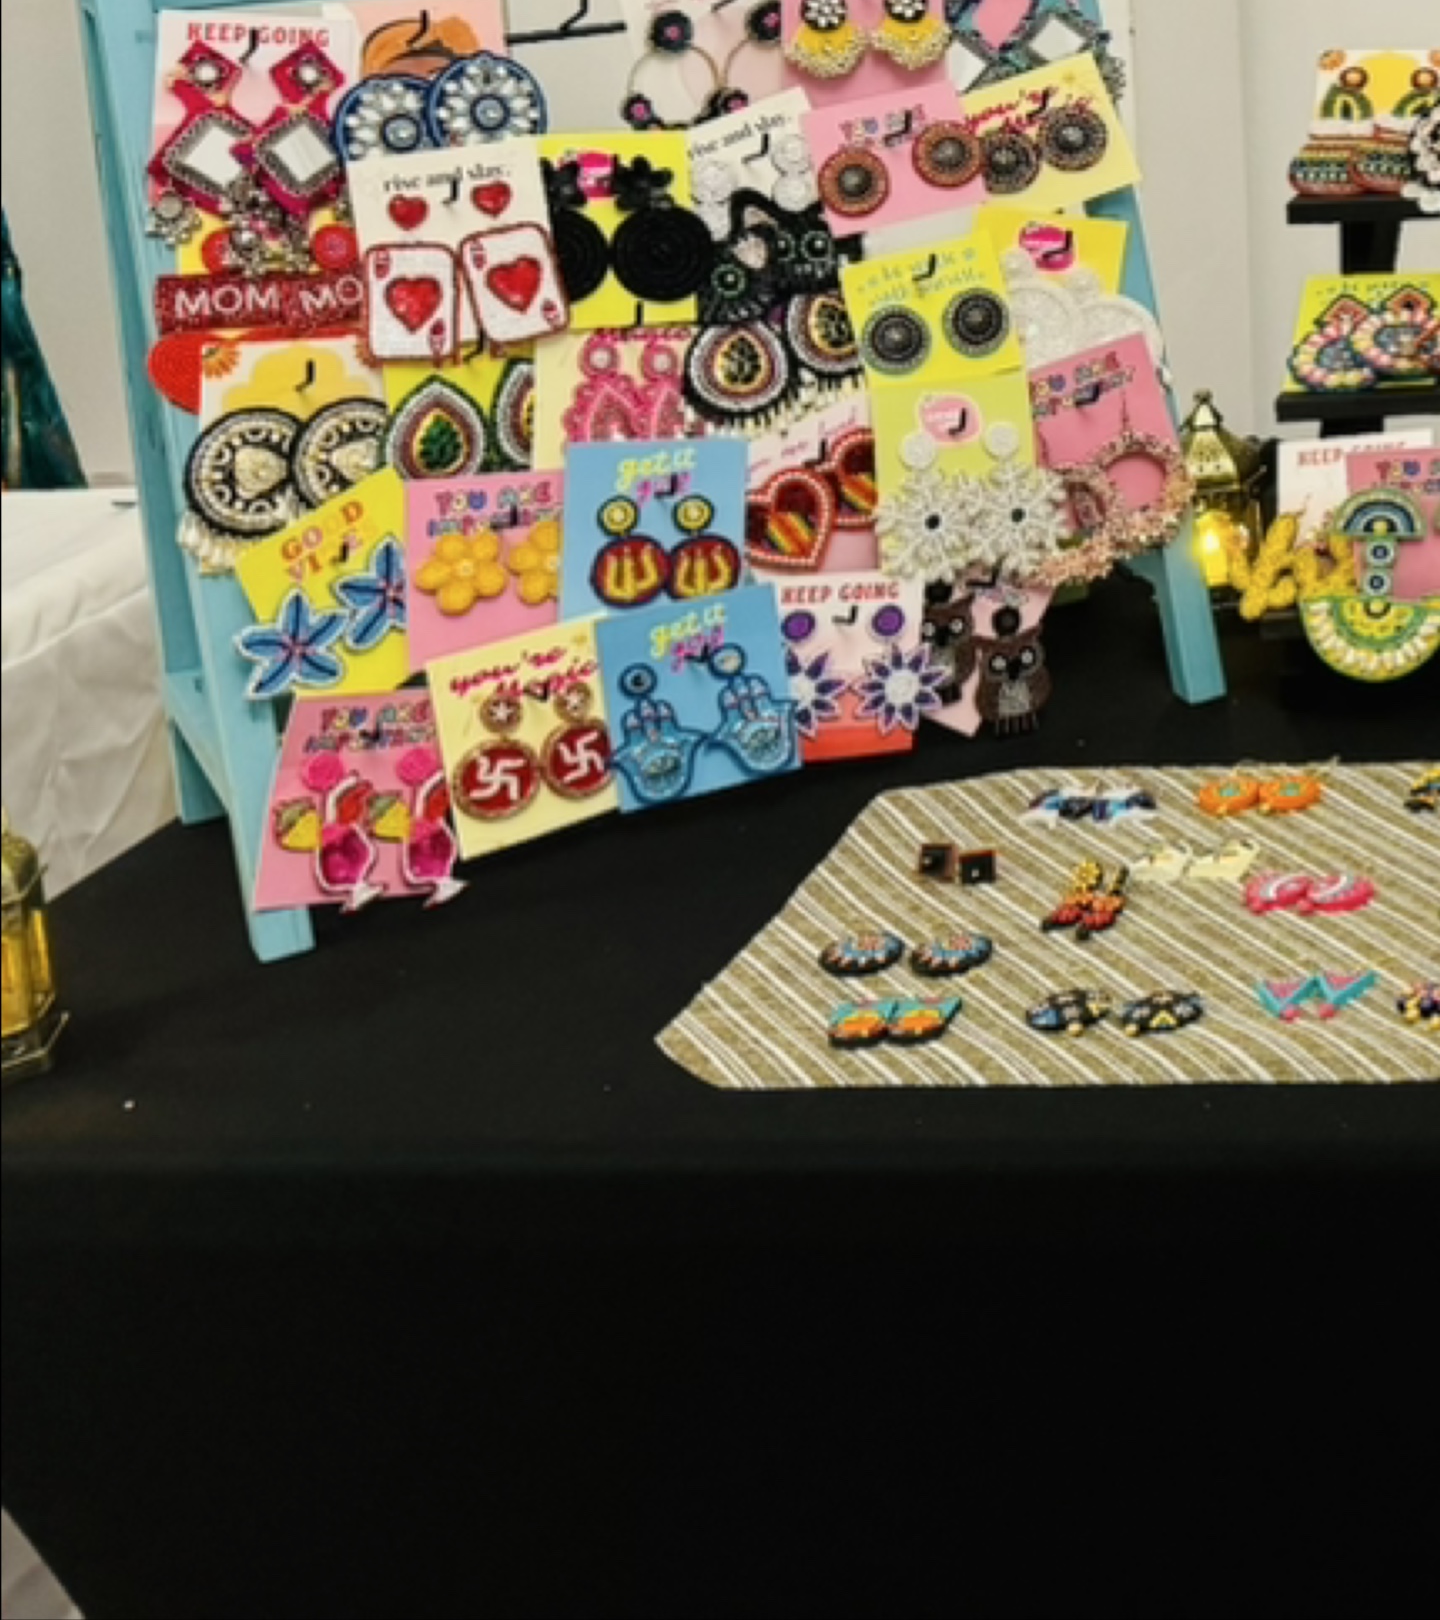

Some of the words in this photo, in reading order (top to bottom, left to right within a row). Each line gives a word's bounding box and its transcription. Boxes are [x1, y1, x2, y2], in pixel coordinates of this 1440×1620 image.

[187, 22, 247, 42] KEEP
[257, 26, 331, 48] GOING
[174, 280, 281, 320] MOM
[298, 275, 365, 316] MO
[1296, 447, 1343, 467] KEEP
[781, 585, 833, 605] KEEP
[837, 582, 900, 604] GOING
